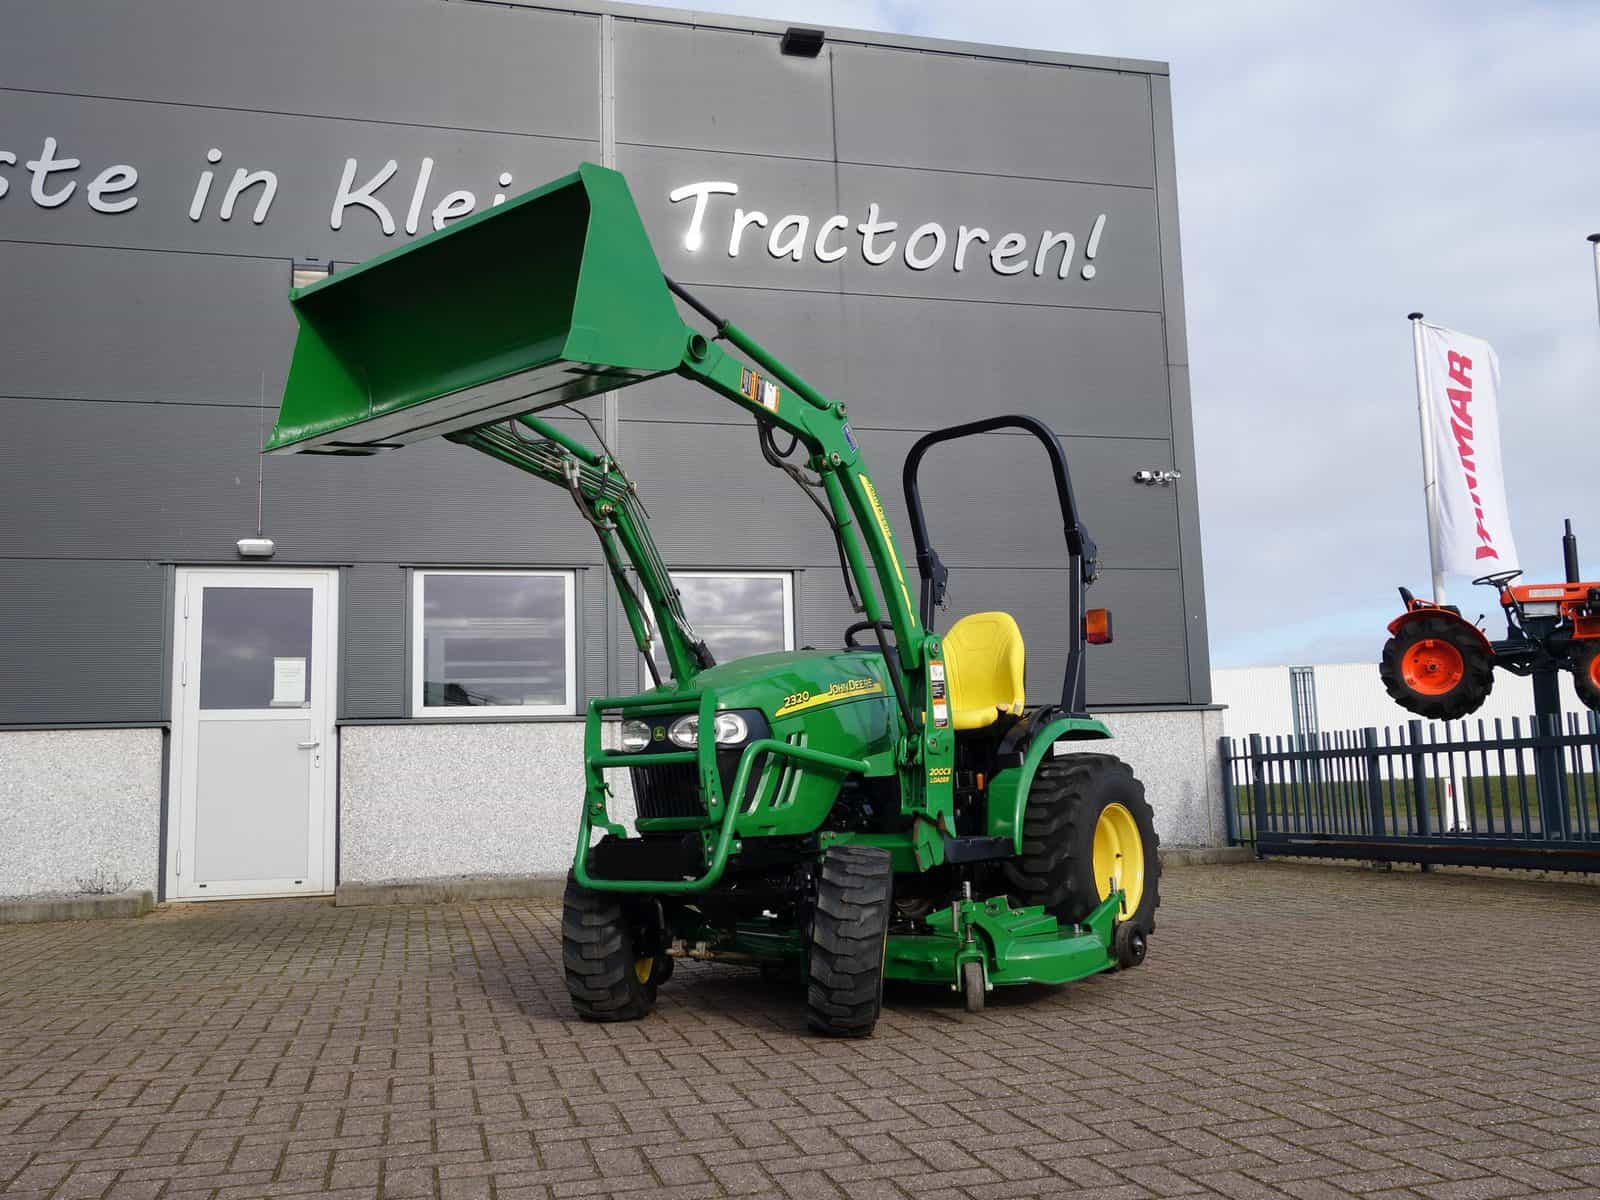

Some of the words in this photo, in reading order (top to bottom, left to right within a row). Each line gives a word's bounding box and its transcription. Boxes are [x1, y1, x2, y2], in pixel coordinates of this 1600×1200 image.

[188, 148, 278, 225] in
[669, 181, 1107, 280] Tractoren!
[784, 691, 810, 708] 2320
